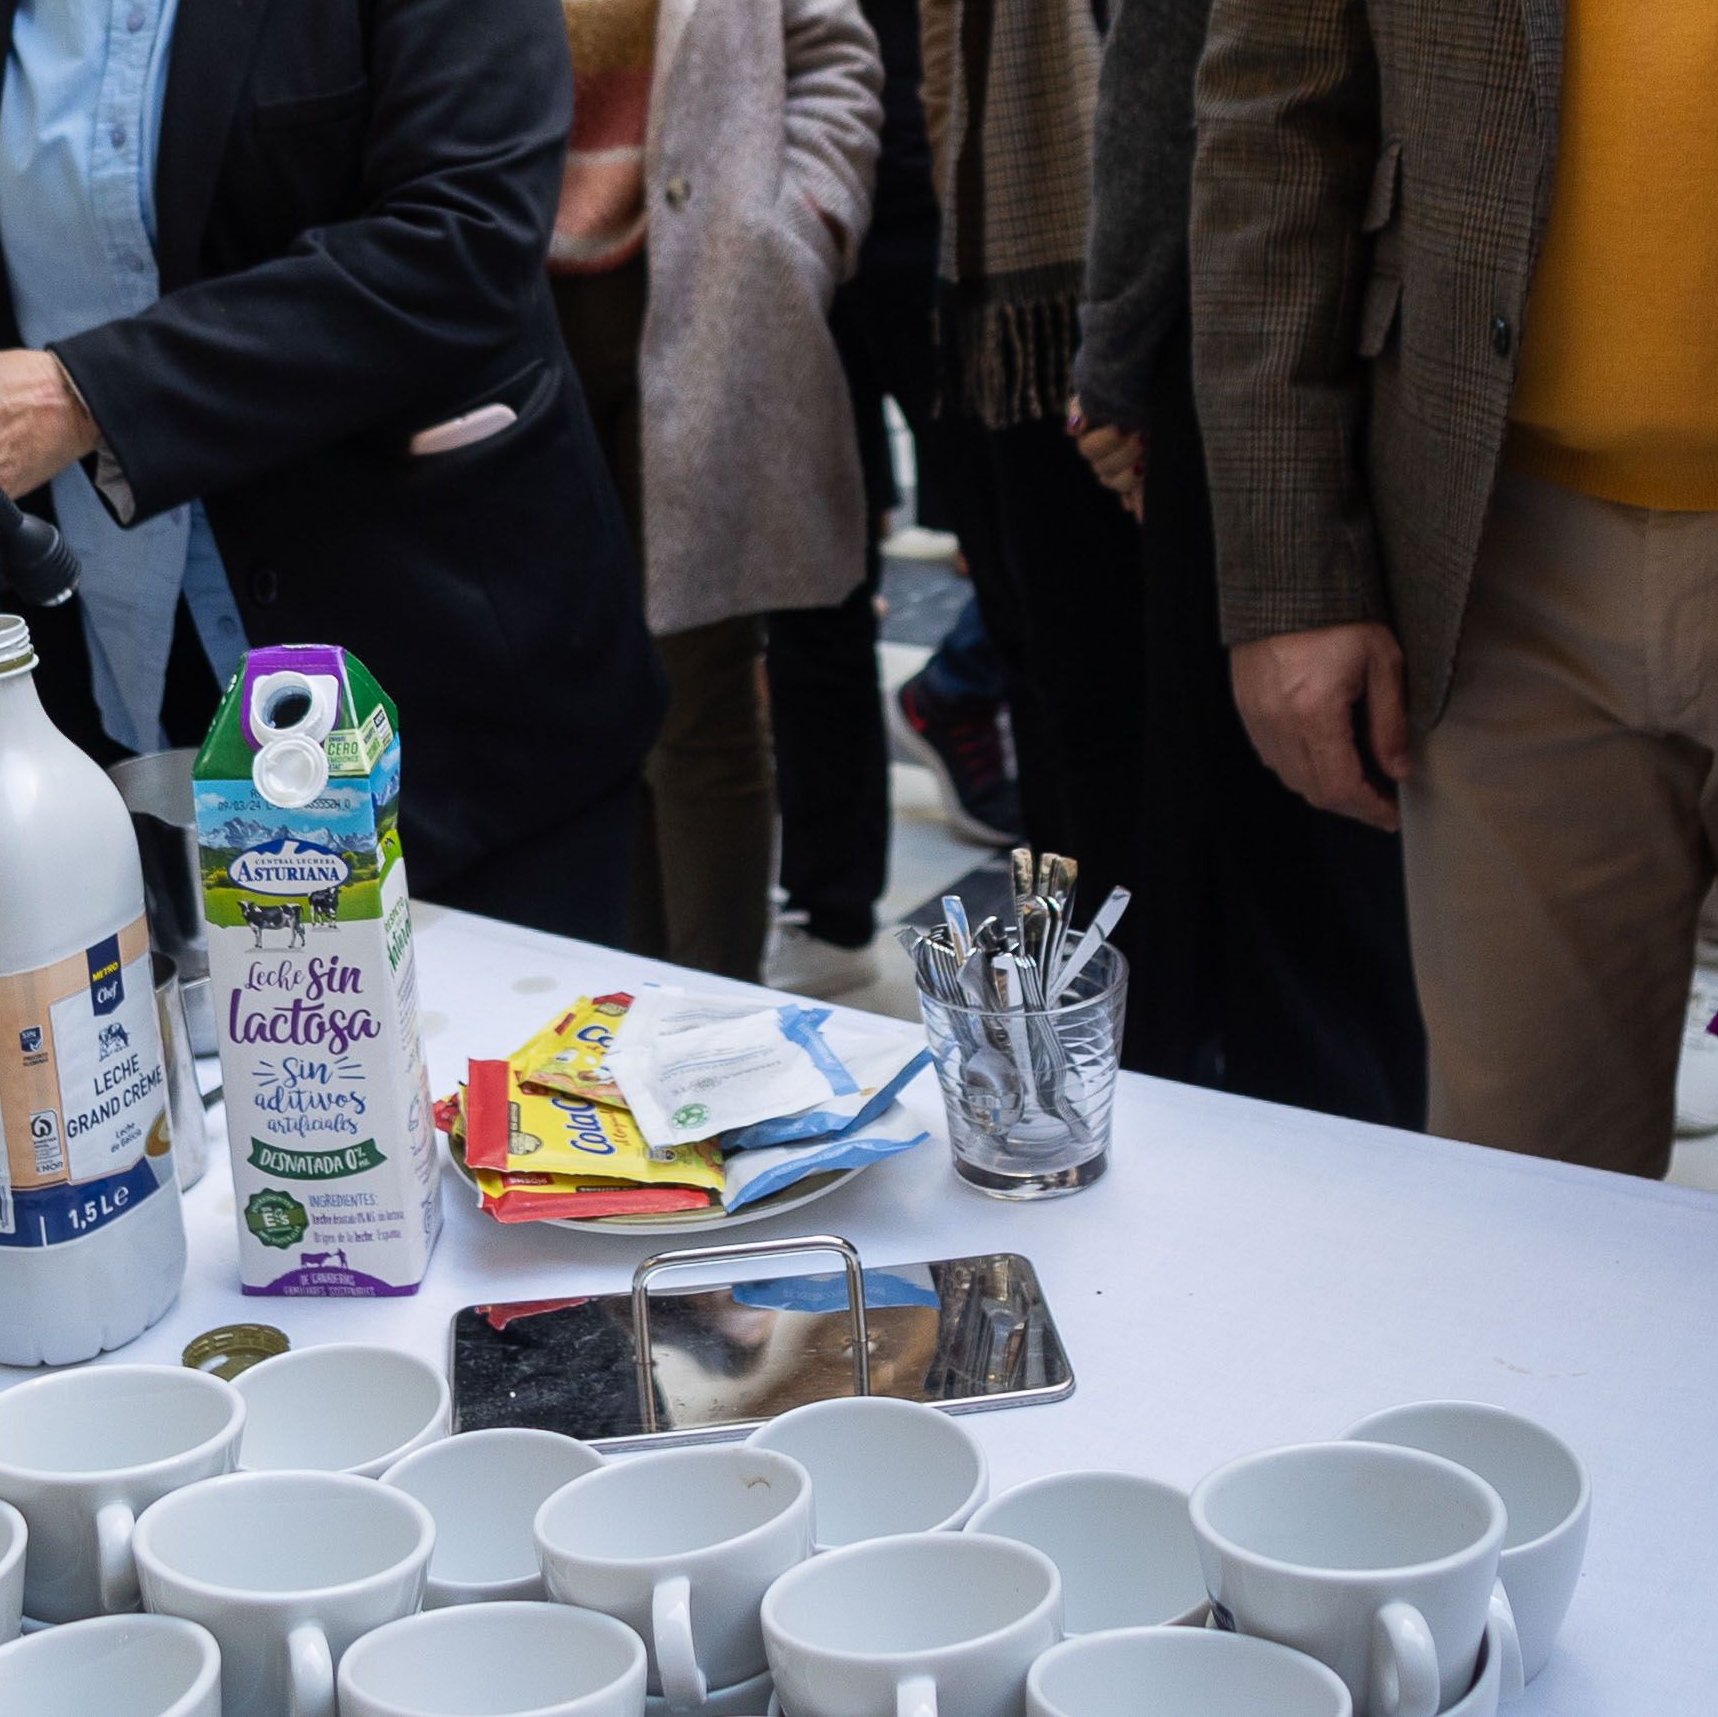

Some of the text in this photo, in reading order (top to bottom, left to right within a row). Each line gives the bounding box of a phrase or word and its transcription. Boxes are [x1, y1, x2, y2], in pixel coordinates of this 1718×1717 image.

[328, 742, 358, 755] CERO
[238, 860, 340, 882] ASTURIANA
[296, 857, 336, 865] LECHERA
[92, 961, 119, 982] METRO
[245, 960, 305, 991] Leche
[97, 981, 118, 1004] Chef
[230, 988, 381, 1055] lactosa
[94, 1054, 140, 1097] LECHE
[67, 1064, 164, 1139] GRAND CRÈME
[255, 1086, 366, 1114] aditivos
[268, 1113, 360, 1138] artificiales
[260, 1148, 343, 1175] DESNATADA
[68, 1201, 98, 1231] 1,5
